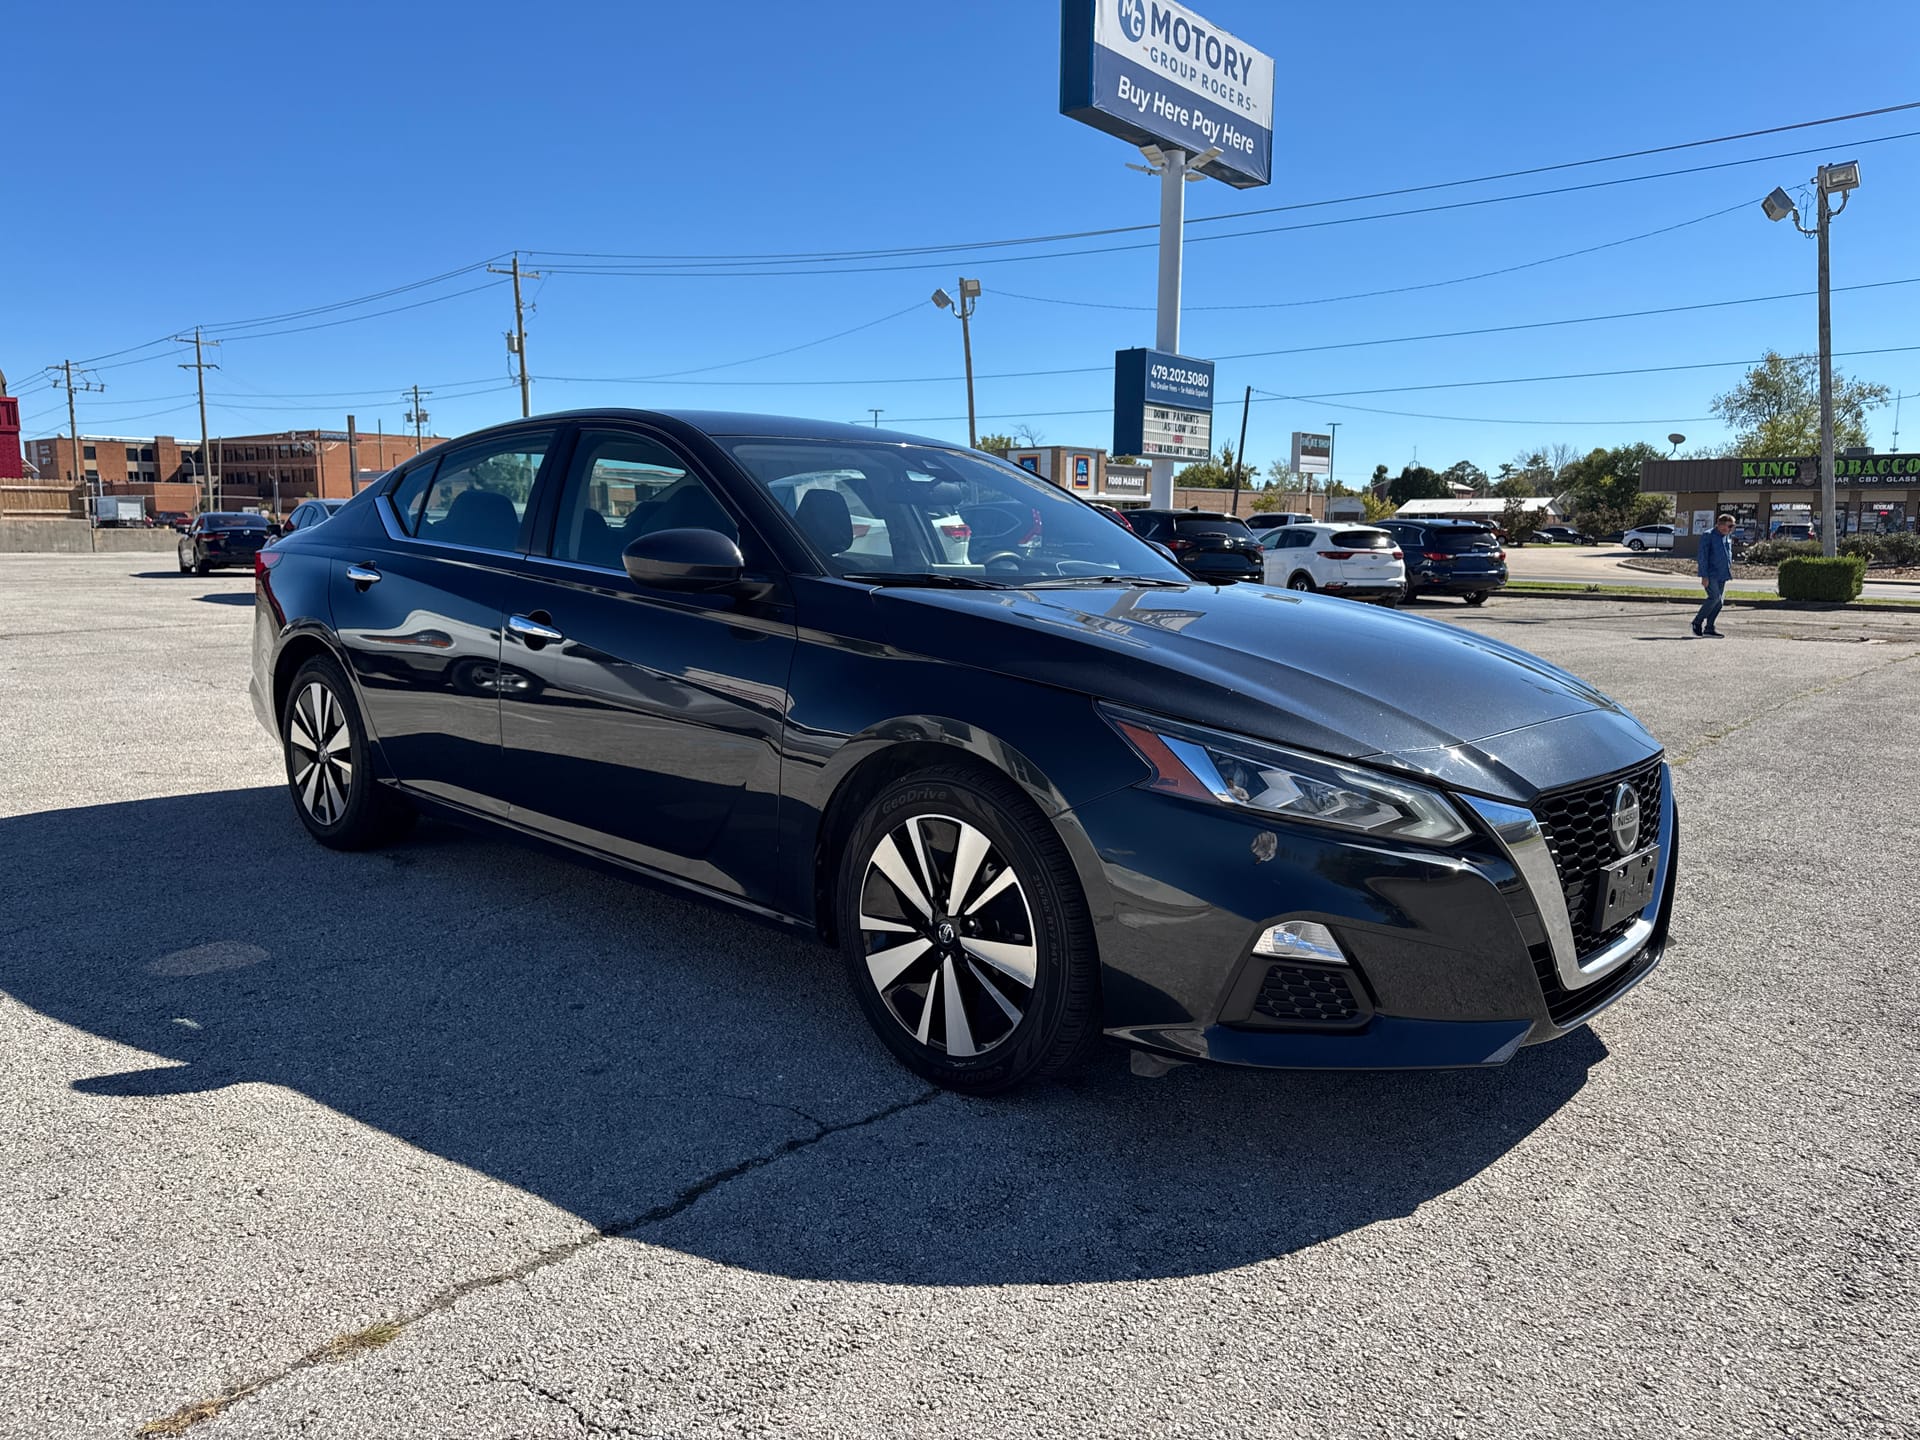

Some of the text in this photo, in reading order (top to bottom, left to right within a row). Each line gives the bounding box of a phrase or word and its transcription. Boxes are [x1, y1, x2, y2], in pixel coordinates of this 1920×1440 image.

[1122, 0, 1142, 37] MG
[1151, 2, 1253, 86] MOTORY
[1118, 75, 1254, 154] Buy Here Pay Here
[1151, 364, 1208, 387] 479.202.5080
[1154, 409, 1200, 424] DOWN PAYMENTS
[1163, 422, 1197, 435] AS LOW AS
[1742, 457, 1920, 477] KING OBACCO
[1108, 476, 1144, 487] FOOD MARKET
[882, 787, 947, 814] GeoDrive
[1617, 811, 1638, 827] NISS
